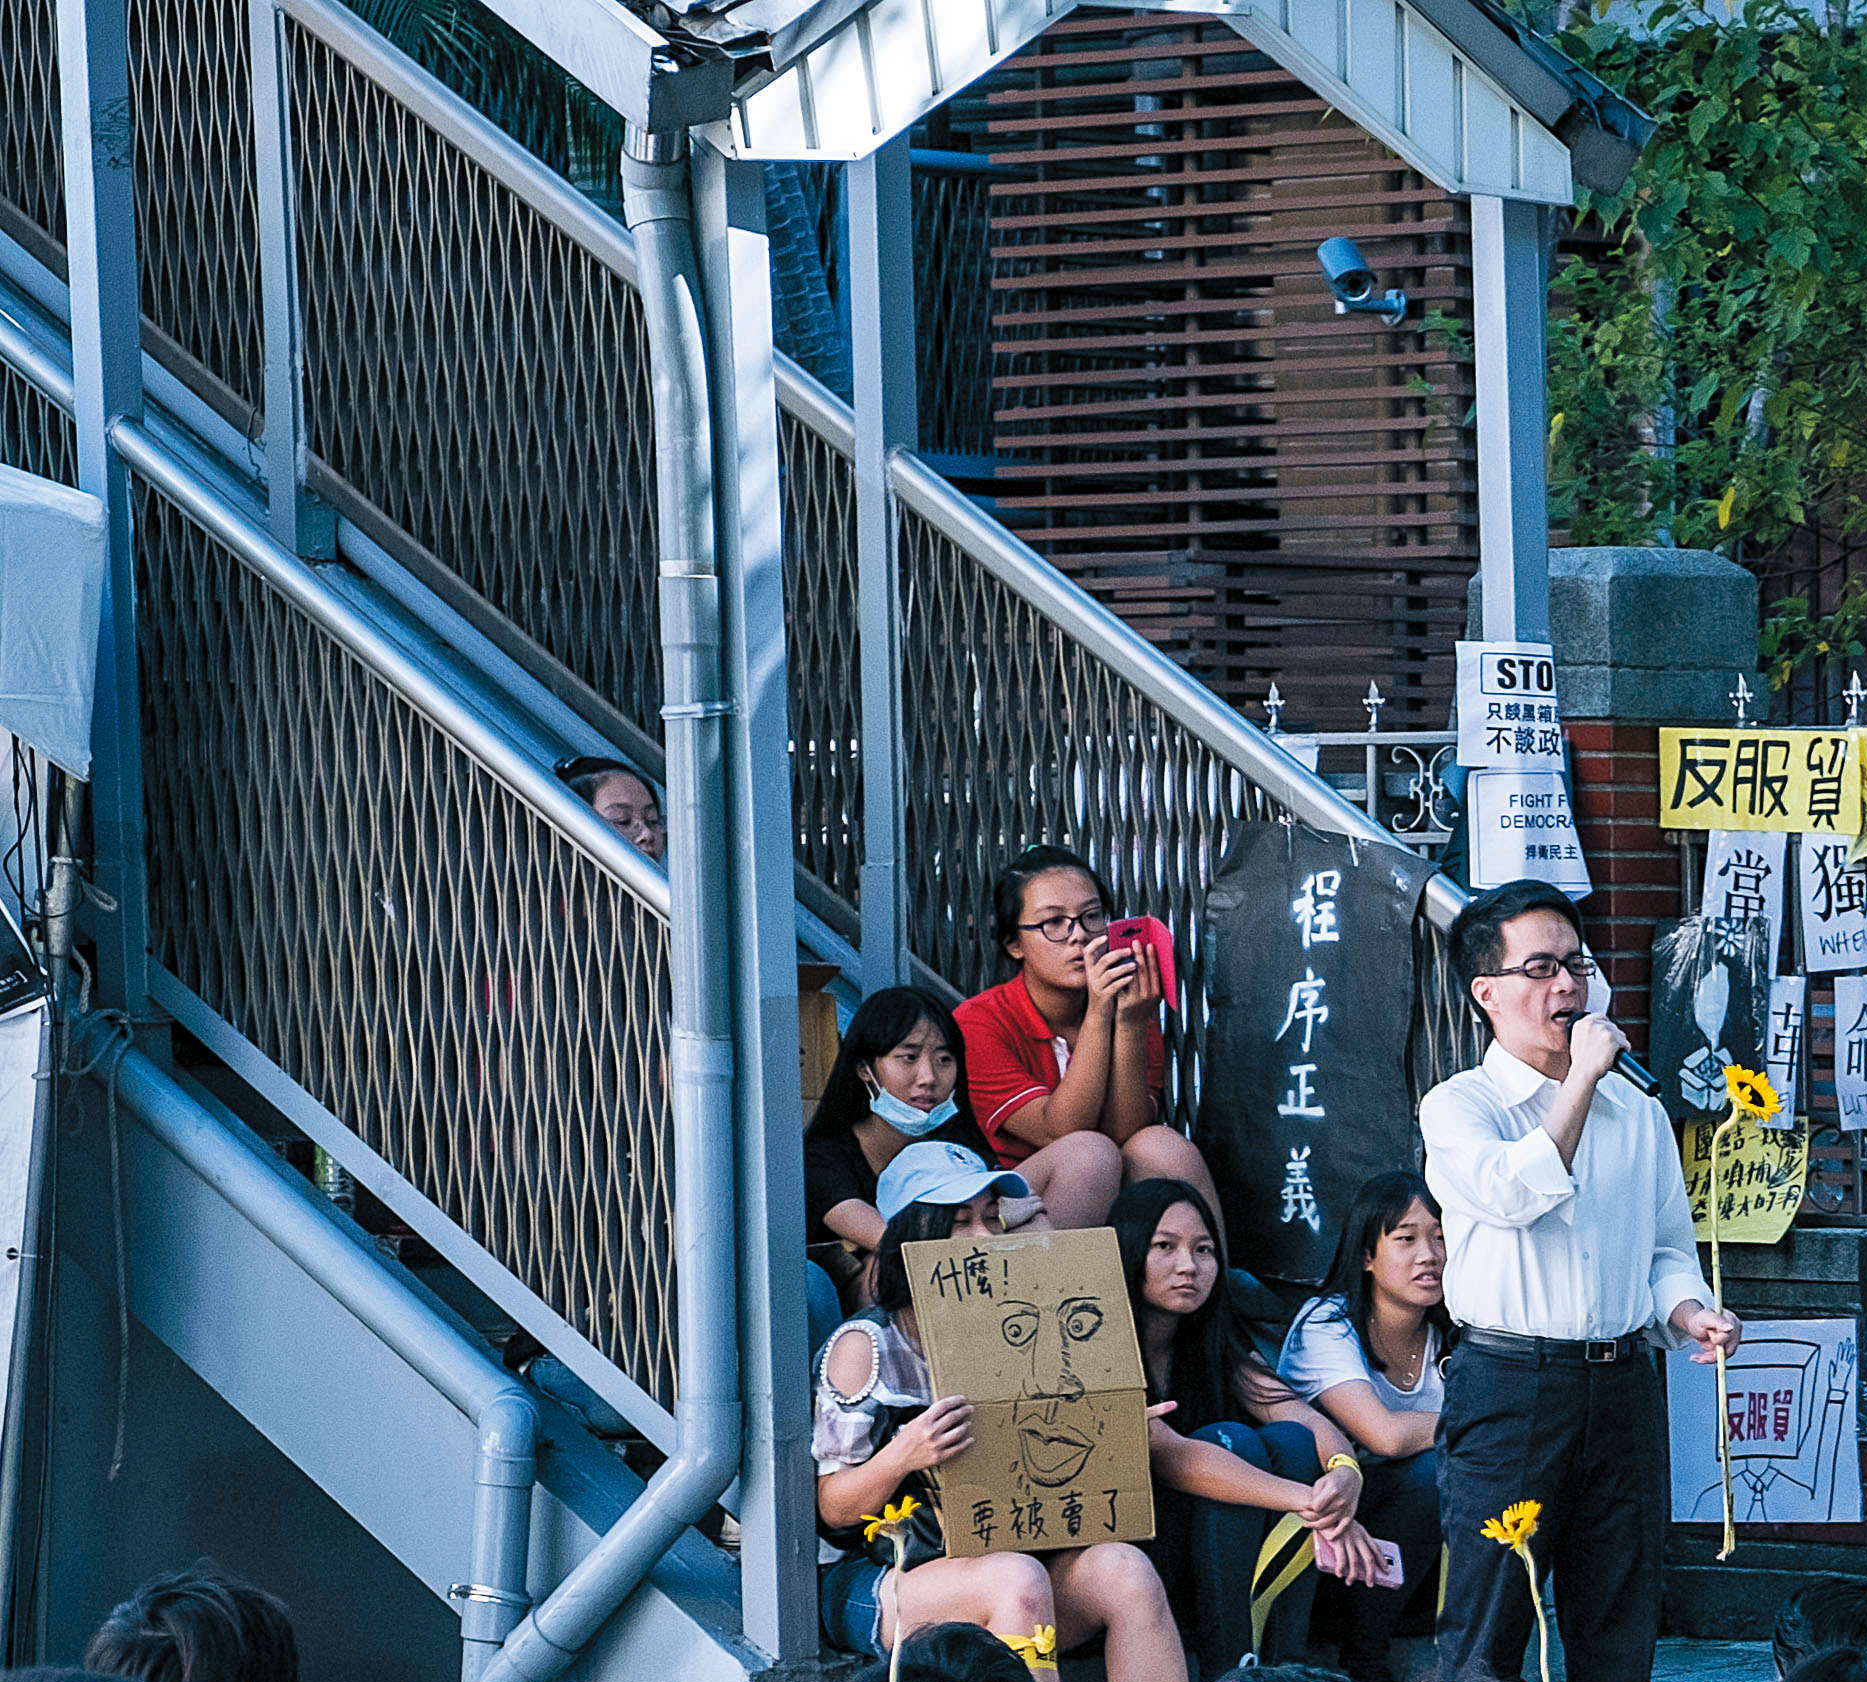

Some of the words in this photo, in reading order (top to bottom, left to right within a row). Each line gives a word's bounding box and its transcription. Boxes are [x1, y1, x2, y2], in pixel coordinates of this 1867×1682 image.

[1670, 736, 1848, 828] 反服貿
[1274, 870, 1342, 1233] 程序正義
[971, 1489, 1118, 1546] 要被賣了
